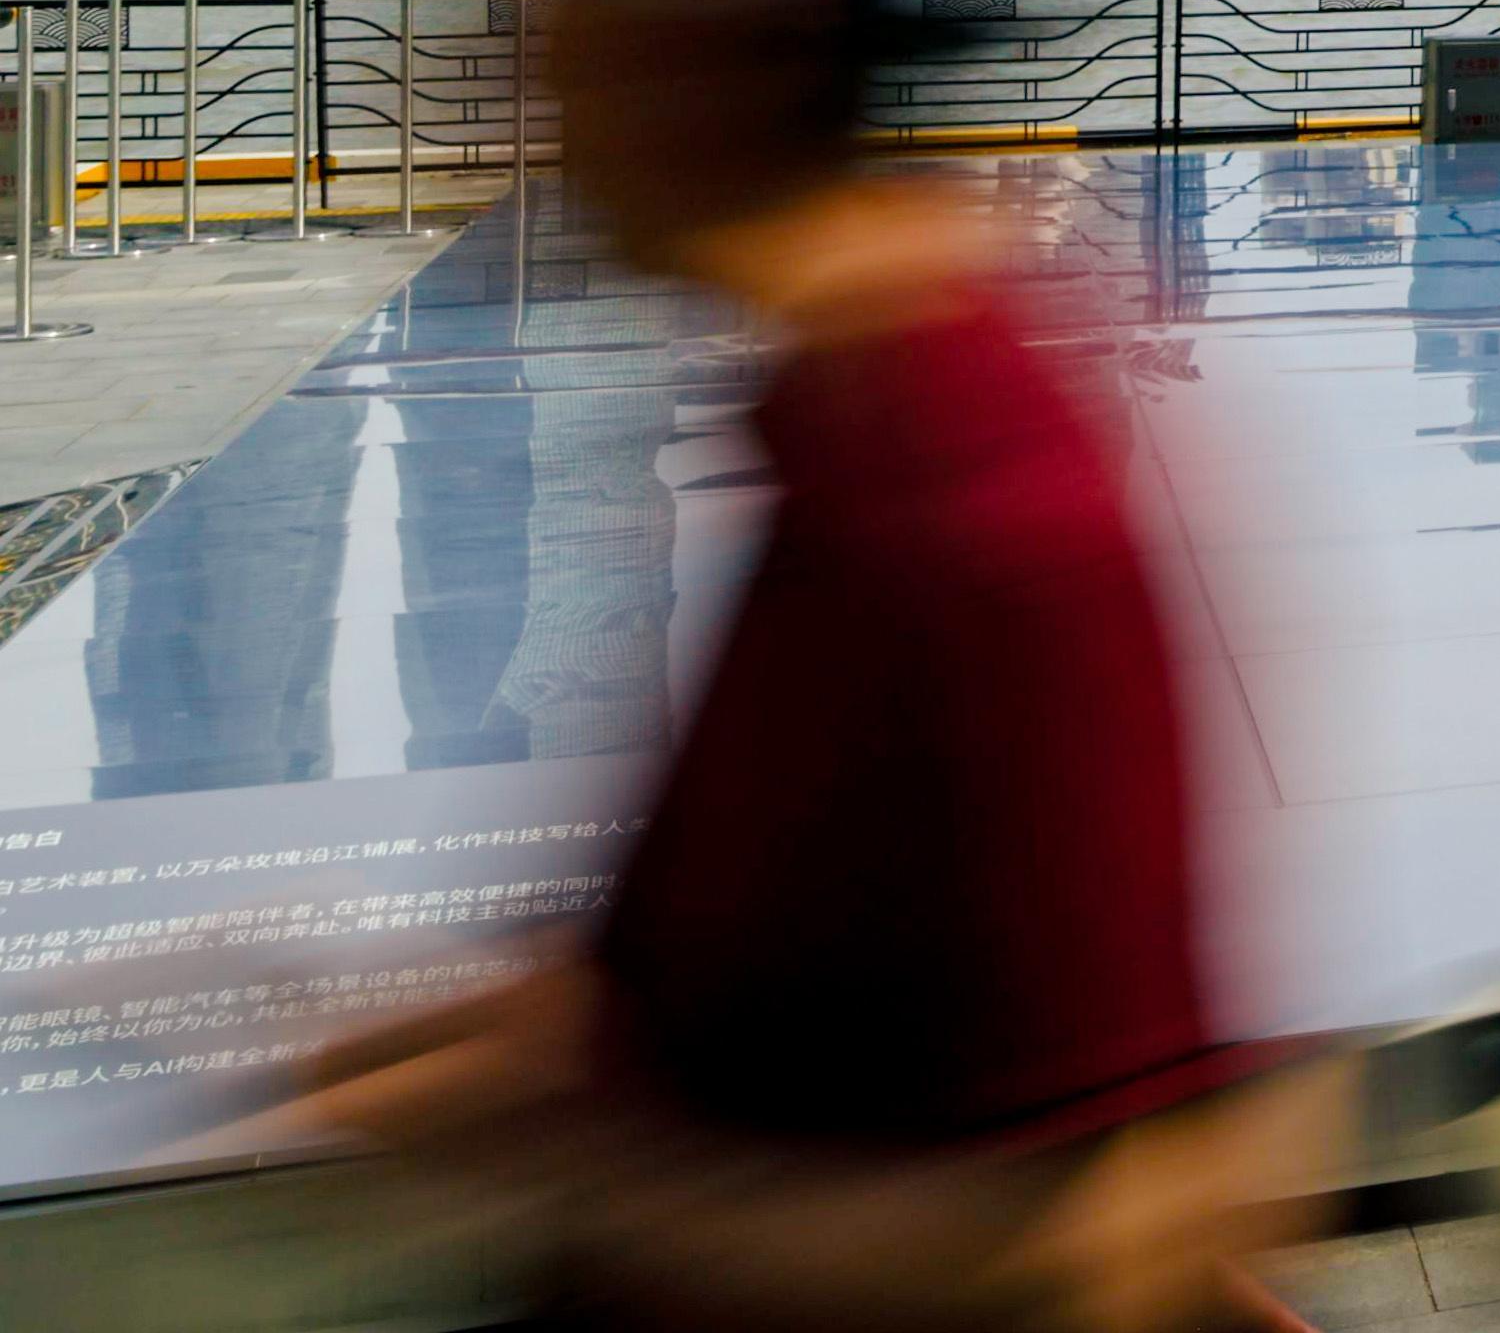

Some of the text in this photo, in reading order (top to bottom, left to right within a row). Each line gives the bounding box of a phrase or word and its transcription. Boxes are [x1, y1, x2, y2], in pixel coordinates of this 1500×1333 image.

[0, 830, 63, 851] 告白
[0, 894, 613, 972] 边界、彼此适应、双向奔赴。唯有科技主动贴近人
